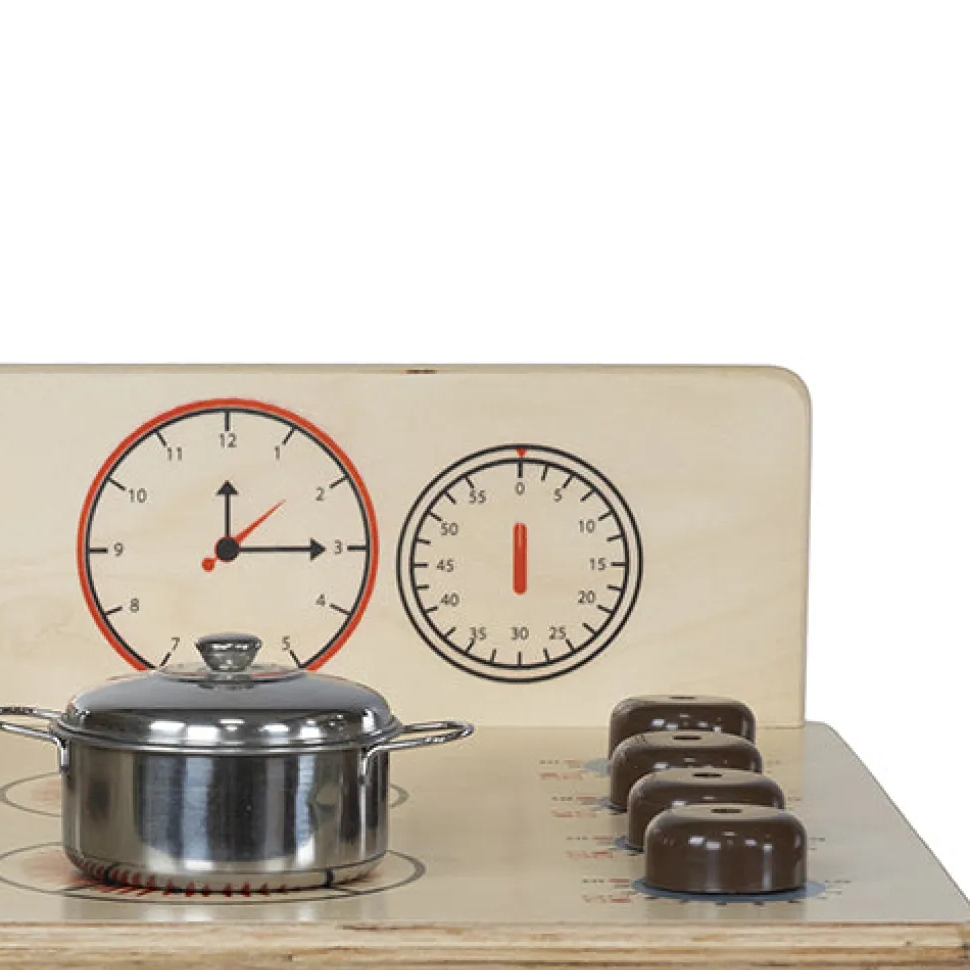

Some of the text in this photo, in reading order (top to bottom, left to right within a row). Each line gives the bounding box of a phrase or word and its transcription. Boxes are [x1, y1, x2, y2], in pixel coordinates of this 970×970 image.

[219, 433, 237, 448] 12
[167, 447, 183, 460] 11
[273, 446, 281, 460] 1
[128, 488, 148, 503] 10
[315, 487, 326, 501] 2
[514, 483, 526, 496] 0
[553, 489, 563, 502] 5
[468, 490, 488, 504] 55
[440, 522, 459, 536] 50
[579, 519, 597, 533] 10
[113, 542, 124, 557] 9
[334, 540, 344, 555] 3
[436, 558, 455, 572] 45
[589, 557, 607, 571] 15
[315, 593, 326, 607] 4
[440, 593, 460, 607] 40
[577, 590, 597, 604] 20
[129, 598, 140, 613] 8
[470, 626, 488, 640] 35
[510, 626, 530, 641] 30
[548, 626, 567, 640] 25
[170, 636, 180, 650] 7
[281, 636, 291, 650] 5
